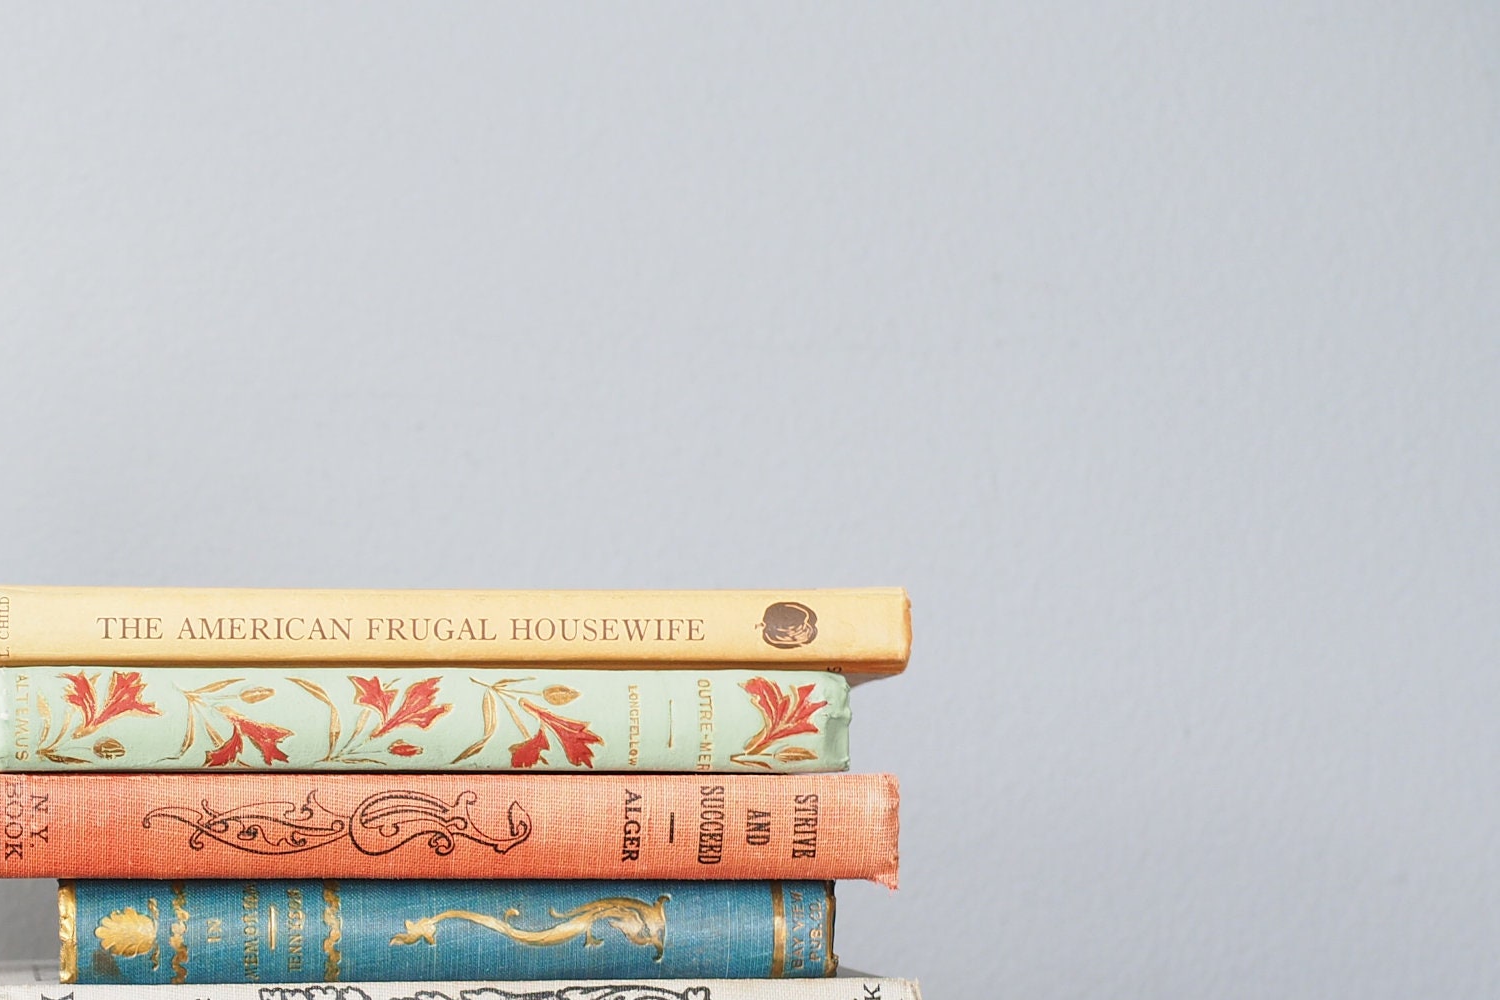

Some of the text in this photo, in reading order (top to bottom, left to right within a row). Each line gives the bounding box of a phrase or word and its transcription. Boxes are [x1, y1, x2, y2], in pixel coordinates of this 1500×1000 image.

[96, 617, 706, 642] THE AMERICAN FRUGAL HOUSEWIFE
[15, 673, 29, 761] ALTEMUS
[628, 684, 639, 767] LONGFELLOW
[696, 679, 713, 771] OUTRE-MER
[4, 780, 24, 861] BOOK
[621, 788, 643, 862] ALGER
[697, 785, 725, 865] SUCCEED
[746, 808, 771, 846] AND
[791, 794, 819, 859] STRIVE
[206, 918, 222, 943] IN
[791, 890, 805, 969] BAY VIEW
